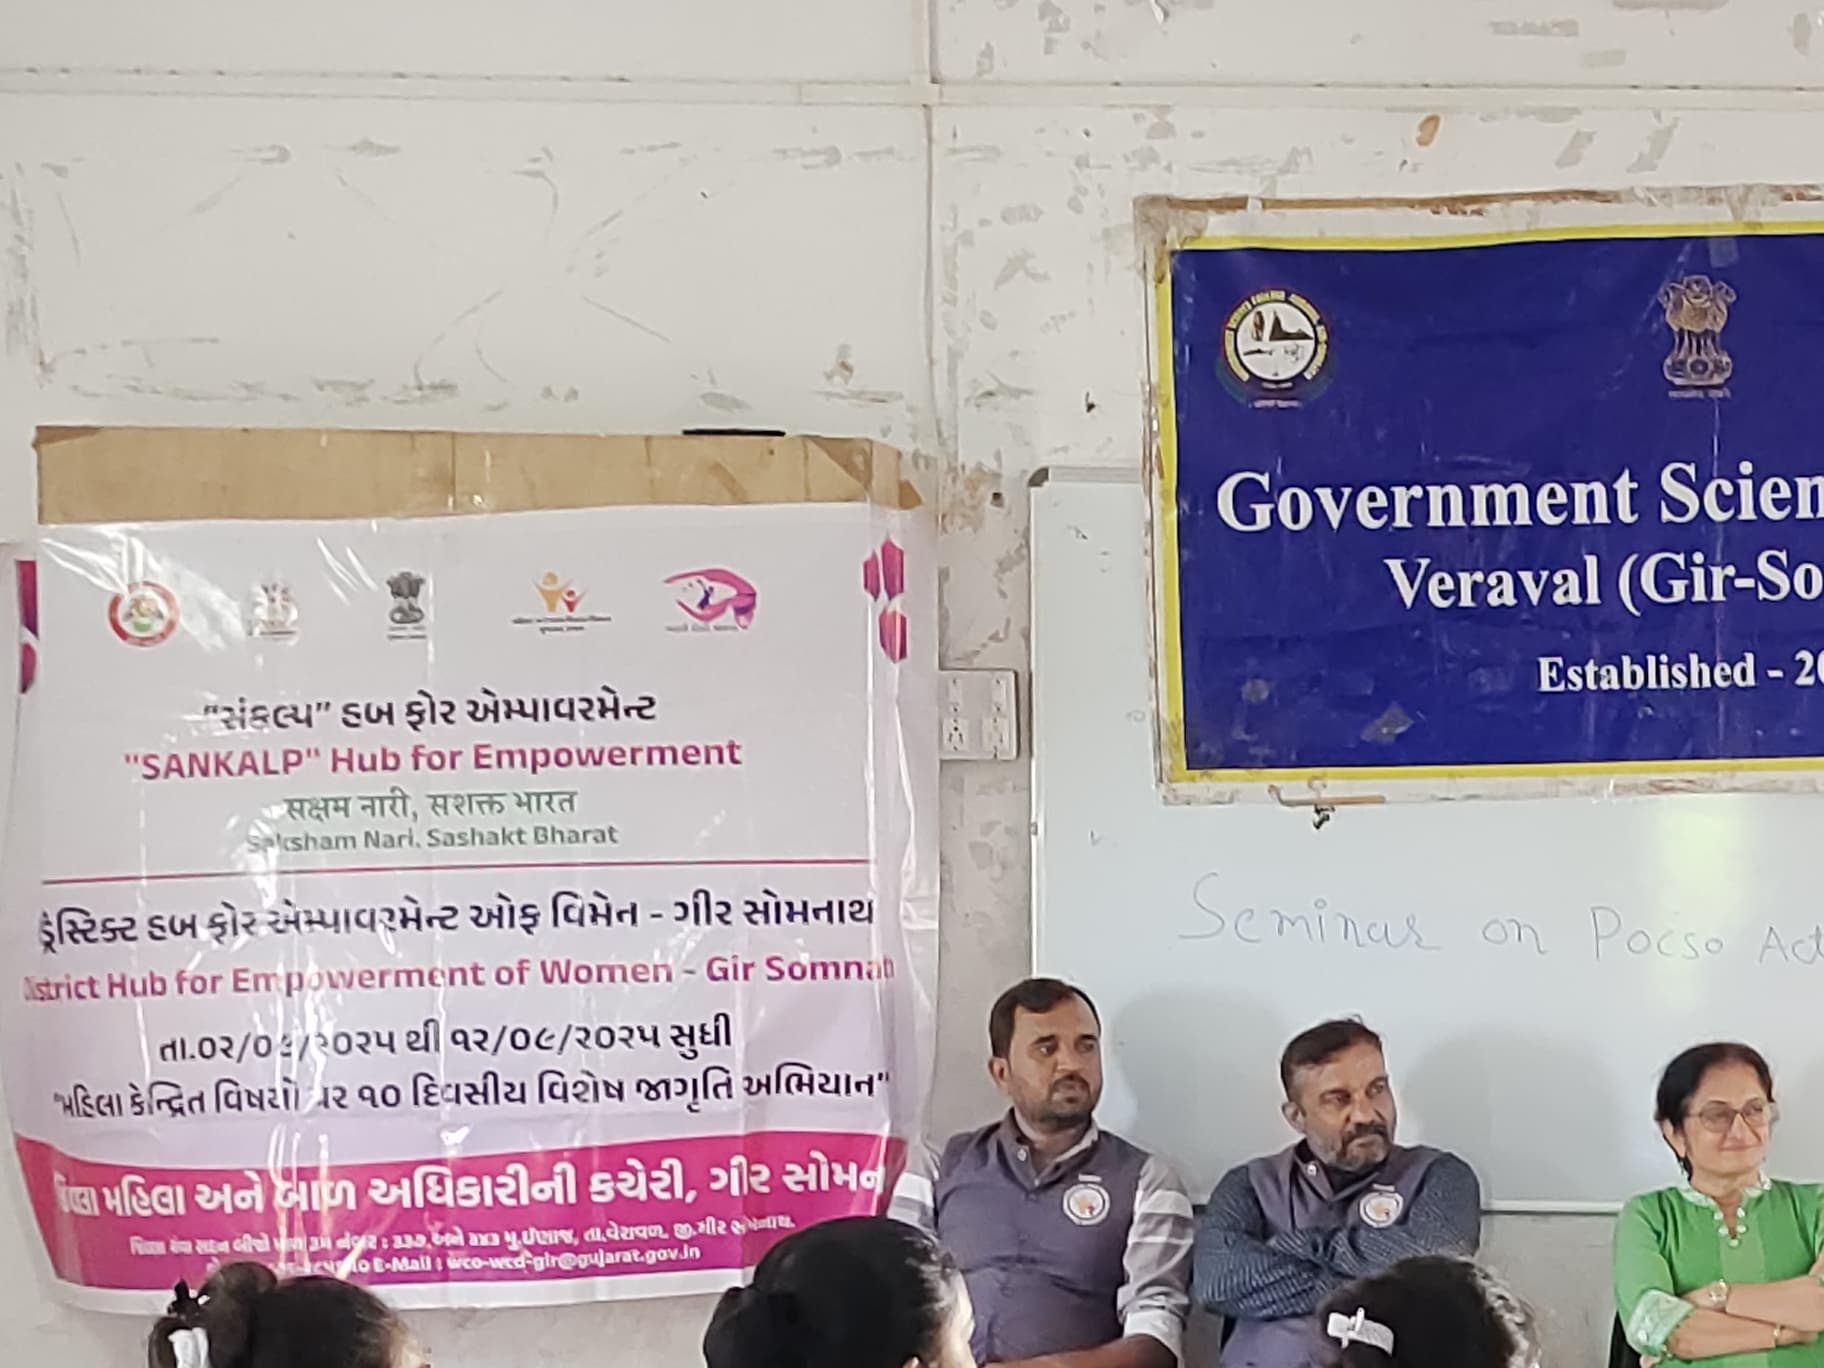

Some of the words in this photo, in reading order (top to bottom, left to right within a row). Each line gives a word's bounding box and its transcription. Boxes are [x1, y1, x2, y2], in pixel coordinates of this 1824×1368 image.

[1217, 466, 1639, 532] Government
[1384, 554, 1601, 609] Veraval
[1539, 653, 1756, 692] Established
[1767, 670, 1783, 678] -
[341, 701, 395, 728] હબ
[405, 689, 456, 732] ફોર
[466, 685, 657, 724] એમ્પાવરમેન્ટ
[124, 747, 320, 780] "SANKALP"
[331, 745, 401, 774] Hub
[411, 744, 463, 770] for
[473, 739, 743, 774] Empowerment
[283, 796, 352, 822] सक्षम
[357, 786, 418, 823] नारी,
[513, 791, 578, 814] भारत
[427, 827, 528, 847] Sashakt
[533, 825, 619, 845] Bharat
[148, 914, 198, 941] હબ
[207, 900, 257, 944] ફોર
[469, 894, 541, 935] ઓફ
[551, 890, 638, 930] વિમેન
[674, 889, 732, 928] ગીર
[743, 889, 874, 926] સોમનાથ
[1178, 871, 1441, 951] Seminar
[1482, 917, 1546, 955] on
[107, 970, 167, 998] Hub
[176, 969, 223, 994] for
[232, 960, 486, 998] Empowerment
[495, 959, 530, 986] of
[540, 959, 673, 984] Women
[707, 955, 755, 982] Gir
[406, 1018, 440, 1052] થી
[451, 1023, 660, 1056] ૧૨/૦૯/૨૦૨૫
[670, 1013, 732, 1060] સુધી
[358, 1084, 400, 1109] ૧૦
[413, 1070, 526, 1106] દિવસીય
[538, 1070, 624, 1104] વિશેષ
[636, 1066, 733, 1112] જાગૃતિ
[744, 1062, 889, 1097] અભિયાન"
[102, 1174, 186, 1217] મહિલા
[195, 1170, 264, 1214] અને
[368, 1163, 577, 1209] અધિકારીની
[590, 1157, 698, 1204] કચેરી,
[710, 1155, 771, 1198] ગીર
[373, 1255, 431, 1273] E-Mail
